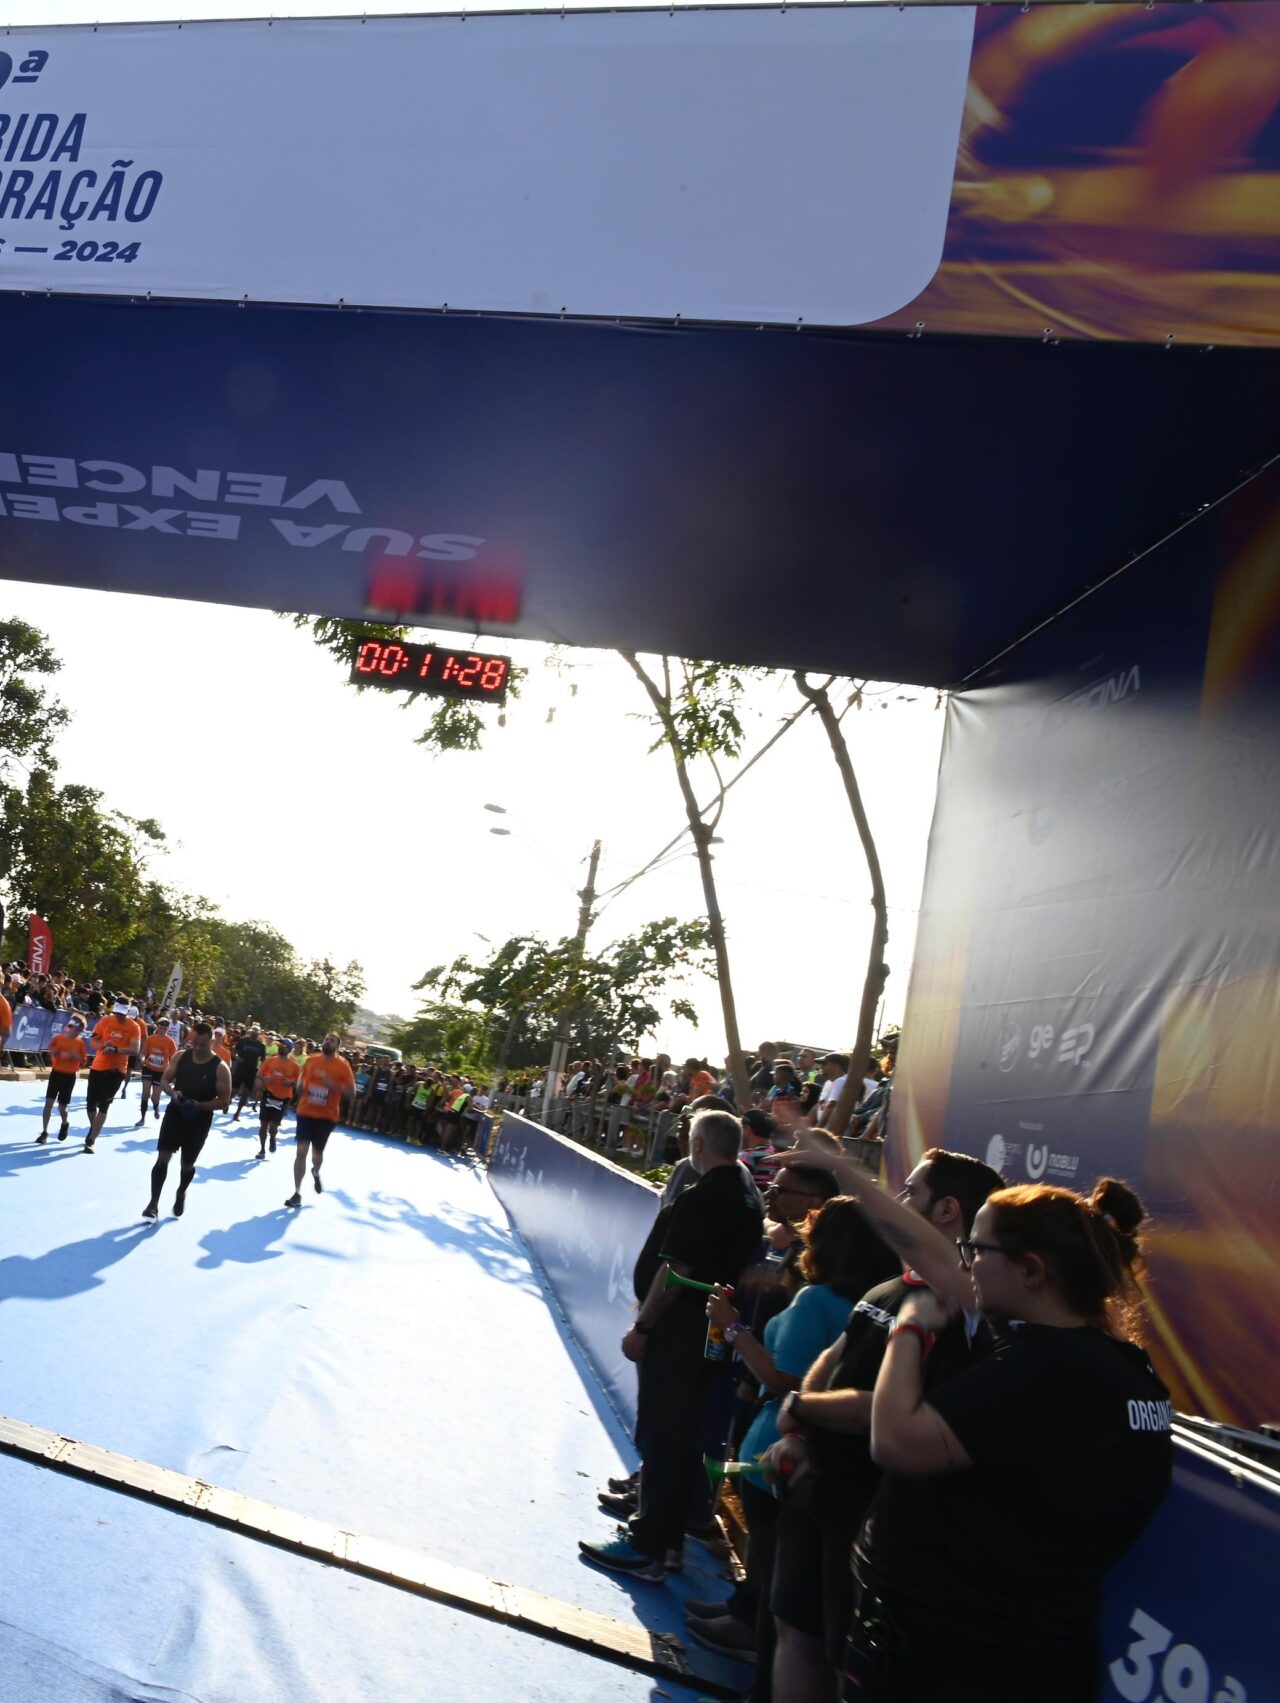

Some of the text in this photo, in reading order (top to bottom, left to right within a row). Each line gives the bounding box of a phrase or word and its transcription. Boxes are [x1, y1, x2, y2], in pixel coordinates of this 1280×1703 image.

[53, 240, 142, 263] 2024
[269, 518, 488, 560] SUA
[357, 643, 505, 689] 00:11:28
